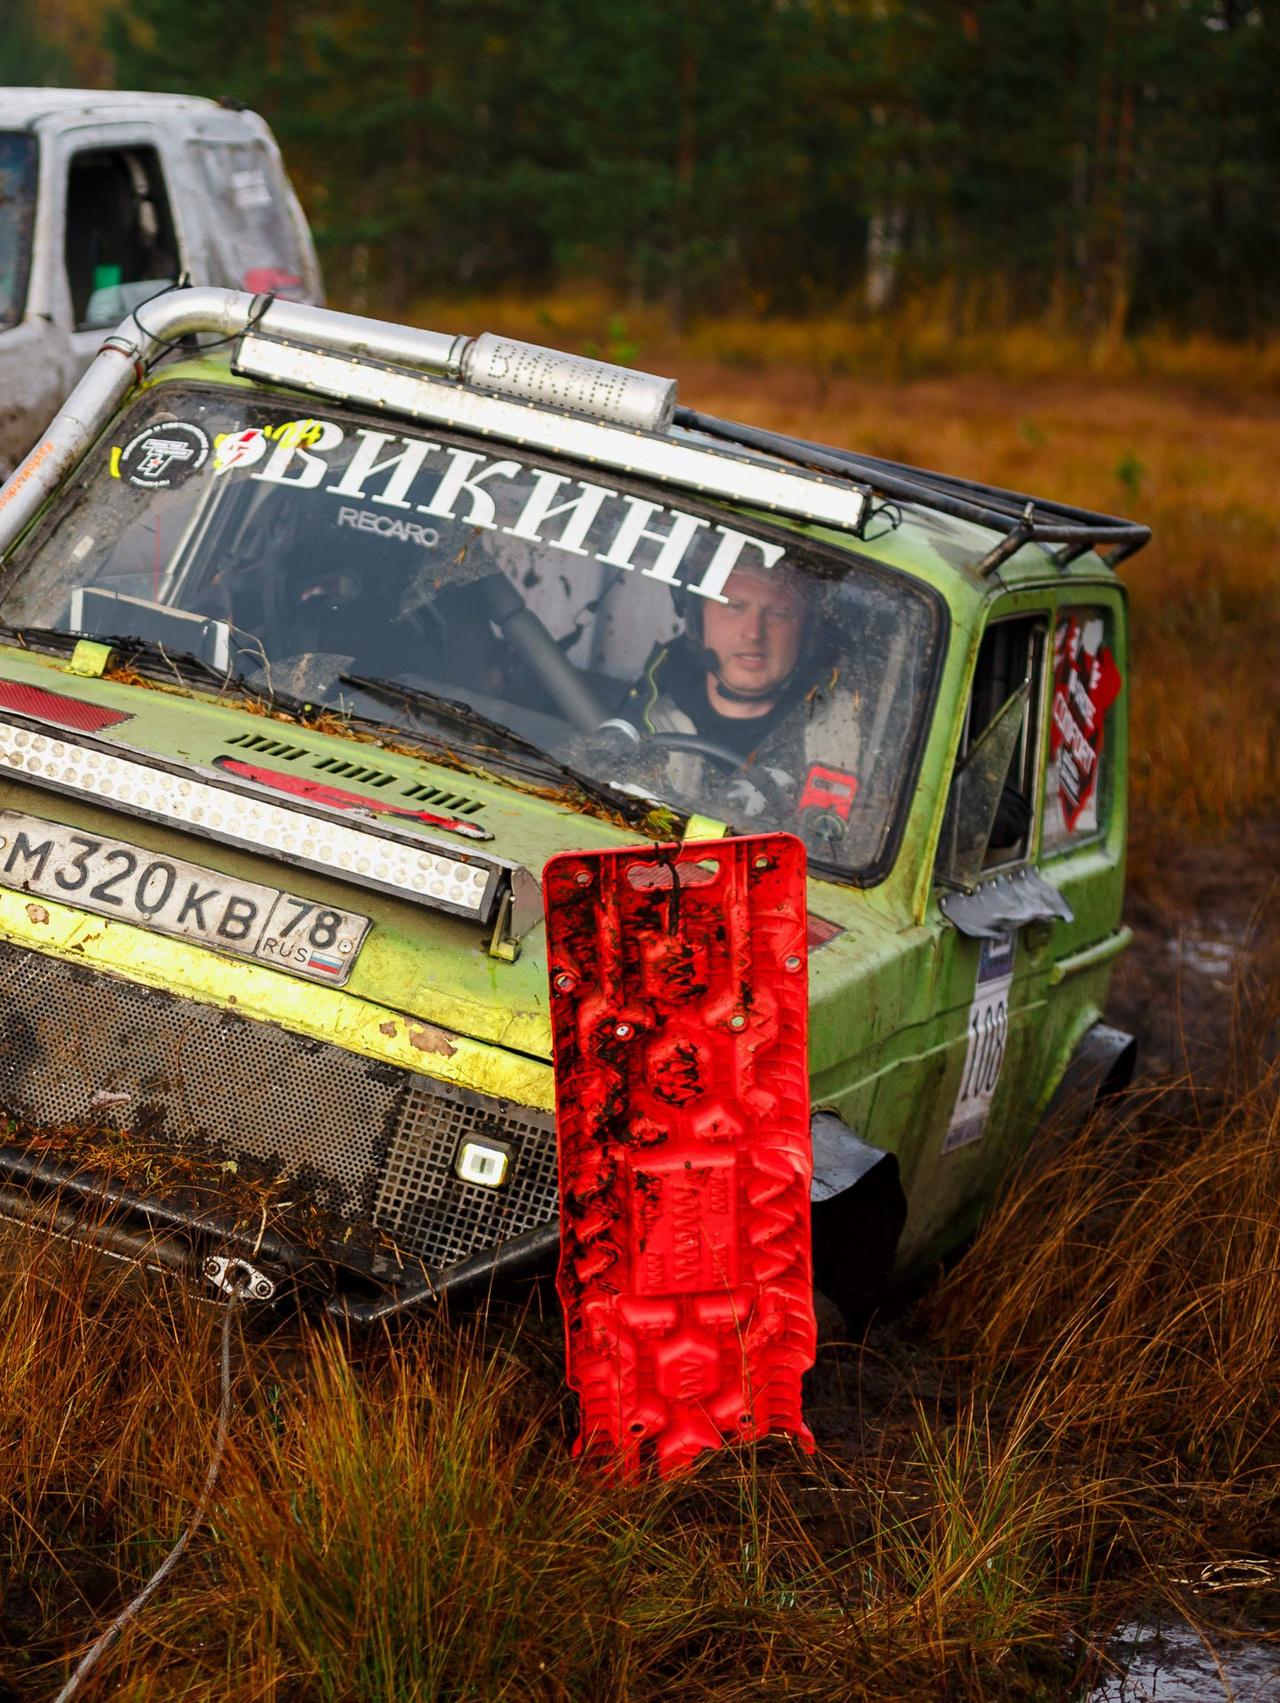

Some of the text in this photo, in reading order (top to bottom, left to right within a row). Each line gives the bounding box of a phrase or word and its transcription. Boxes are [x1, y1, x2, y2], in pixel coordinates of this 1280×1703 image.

[251, 418, 786, 604] ВИКИНГ
[337, 506, 440, 548] RECARO
[278, 899, 345, 950] 78
[262, 938, 308, 963] RUS
[961, 1000, 1008, 1102] 108
